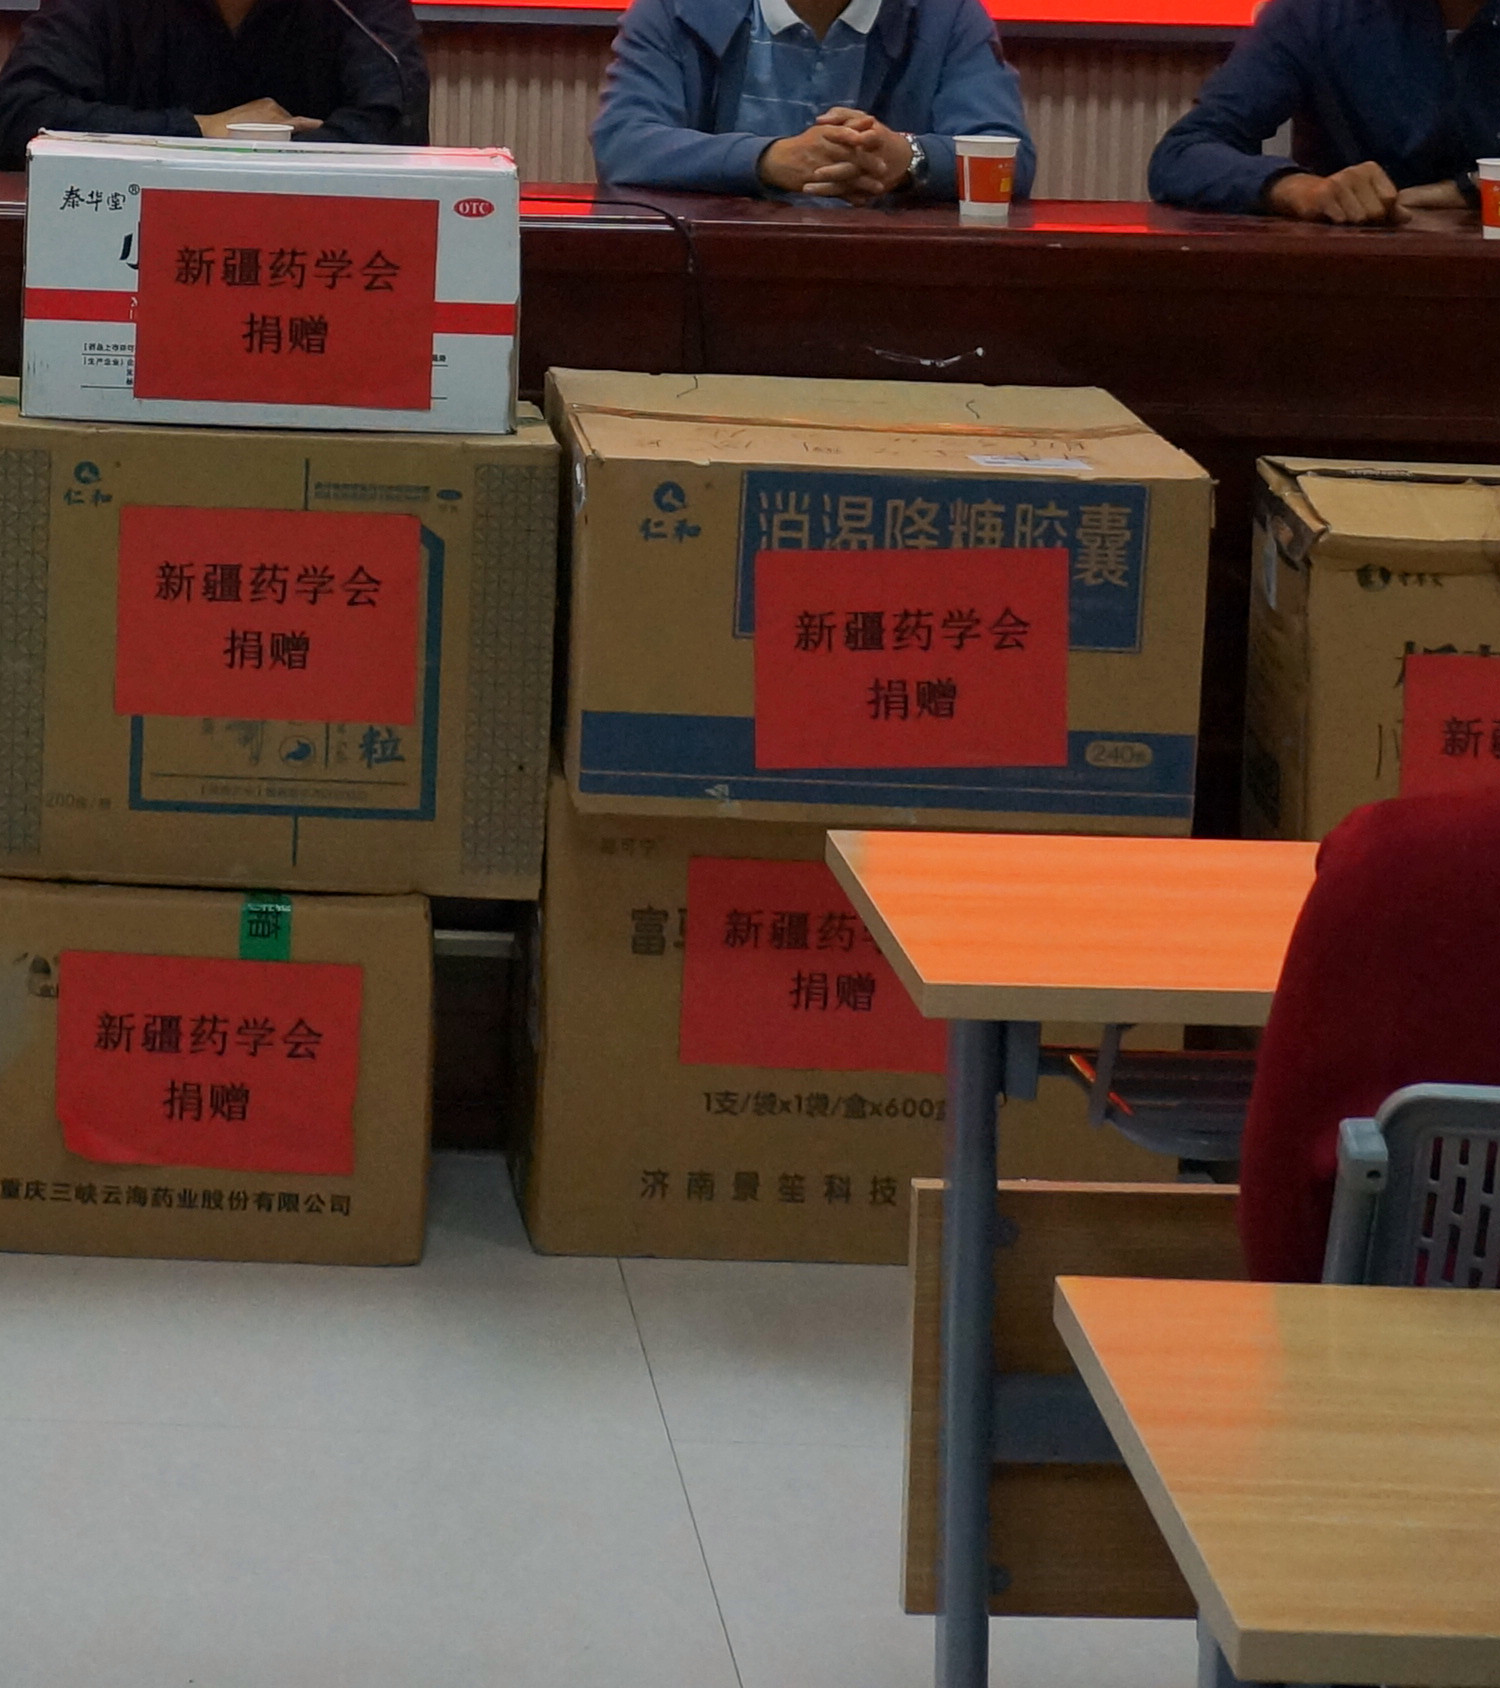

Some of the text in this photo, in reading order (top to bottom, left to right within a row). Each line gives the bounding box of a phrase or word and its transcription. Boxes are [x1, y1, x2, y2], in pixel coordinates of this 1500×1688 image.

[174, 246, 402, 292] 新疆药学会
[241, 312, 329, 355] 捐赠
[154, 561, 383, 609] 新疆药学会
[223, 629, 311, 672] 捐赠
[793, 608, 1031, 653] 新疆药学会
[868, 678, 958, 721] 捐赠
[789, 970, 877, 1013] 捐赠
[94, 1011, 324, 1061] 新疆药学会
[162, 1079, 251, 1123] 捐赠
